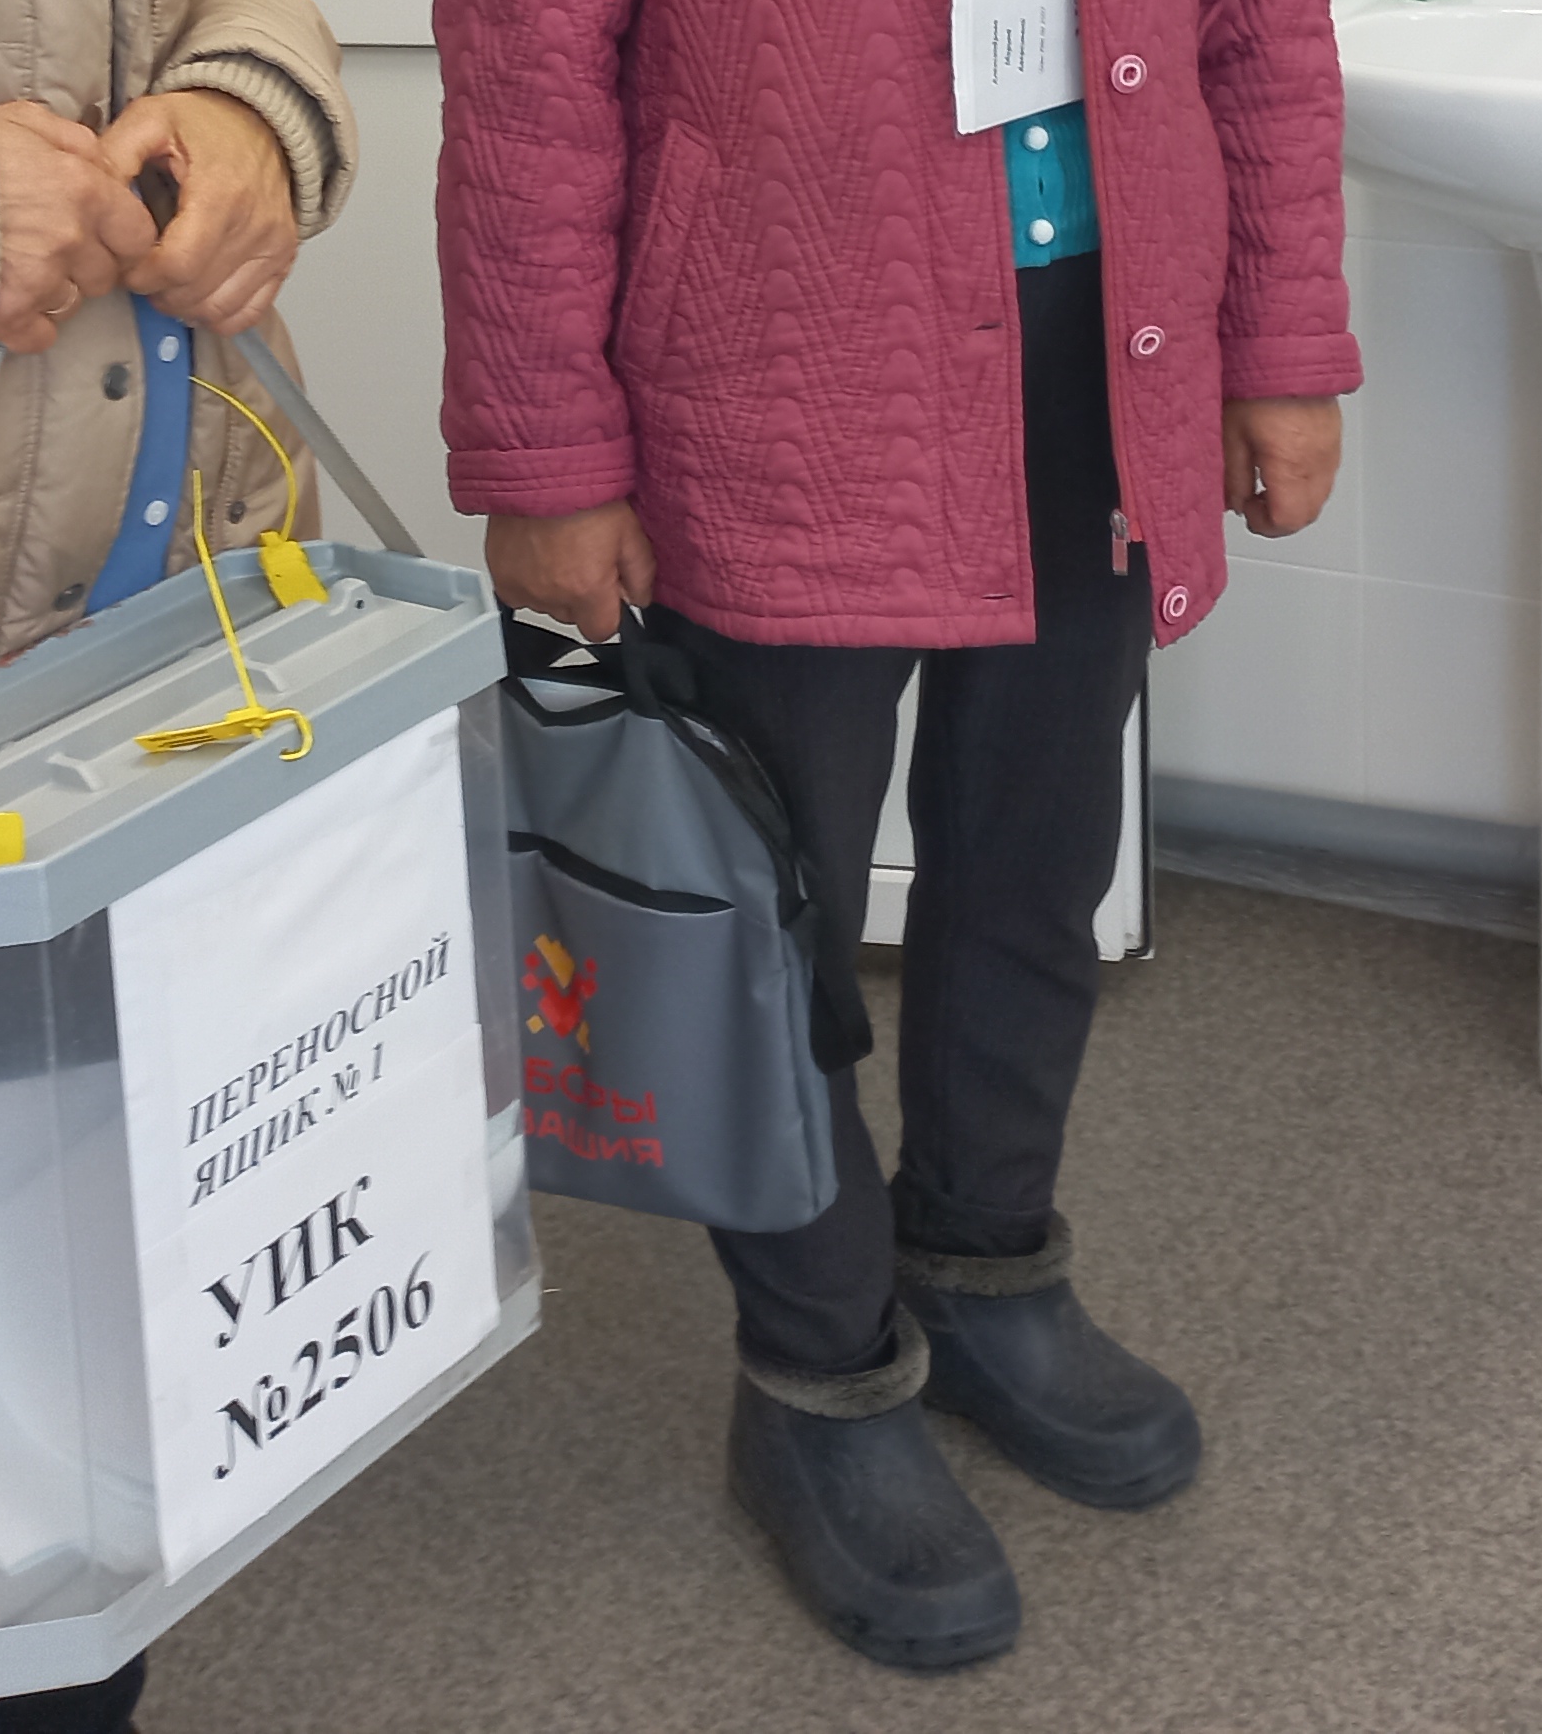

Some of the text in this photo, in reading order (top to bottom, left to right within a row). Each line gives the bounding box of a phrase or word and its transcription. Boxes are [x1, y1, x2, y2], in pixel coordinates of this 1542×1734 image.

[184, 931, 452, 1148] ПЕРЕНОСНОЙ
[325, 1063, 361, 1115] №
[370, 1041, 385, 1083] 1
[524, 1057, 657, 1124] БОРЫ
[201, 1174, 375, 1349] УИК
[213, 1250, 435, 1481] №2506
